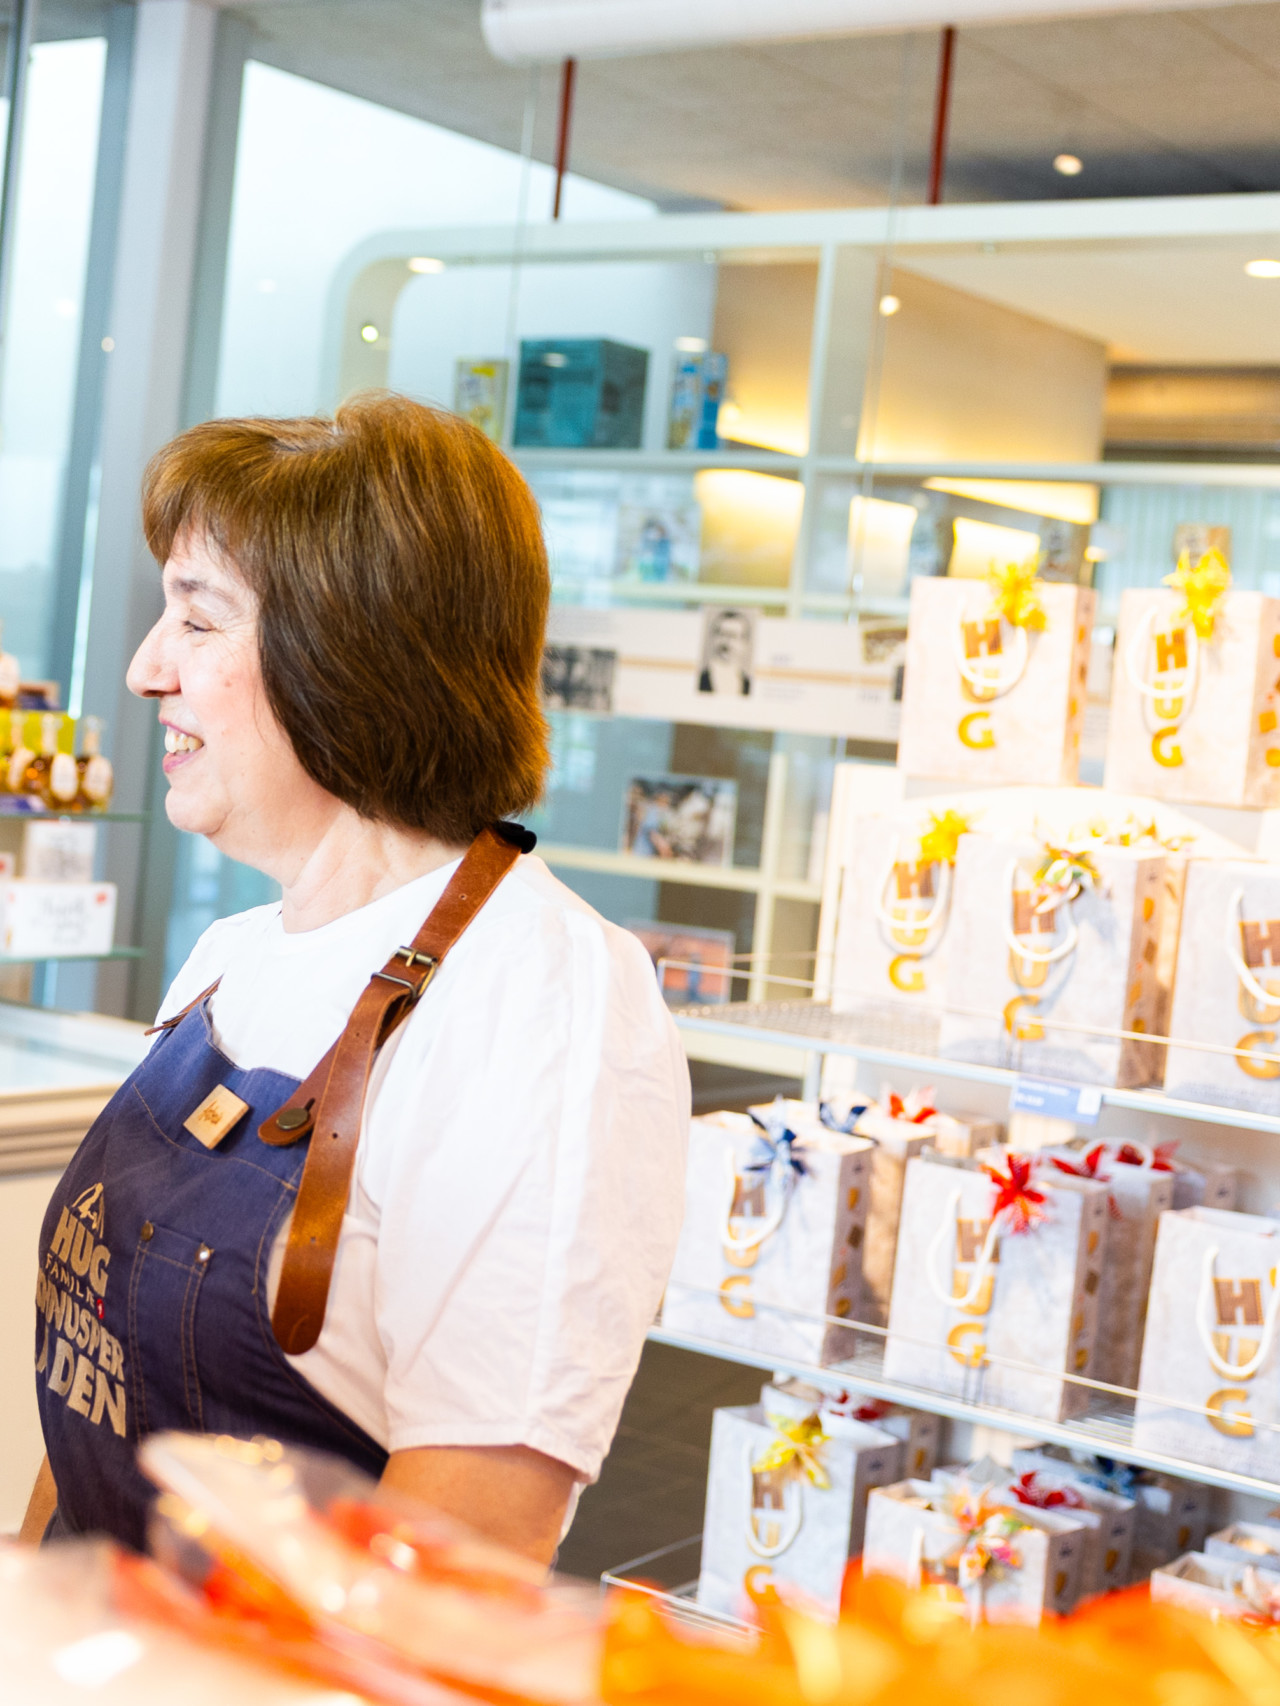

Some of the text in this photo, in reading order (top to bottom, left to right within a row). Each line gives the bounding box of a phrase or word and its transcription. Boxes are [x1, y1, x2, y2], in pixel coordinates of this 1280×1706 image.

[957, 618, 1003, 749] HUG
[1151, 628, 1188, 768] HUG
[887, 860, 936, 992] HUG
[1002, 889, 1056, 1041] HUG
[50, 1204, 111, 1298] HUG
[719, 1174, 767, 1319] HUG
[947, 1218, 1000, 1368] HUG
[1205, 1277, 1265, 1438] HUG
